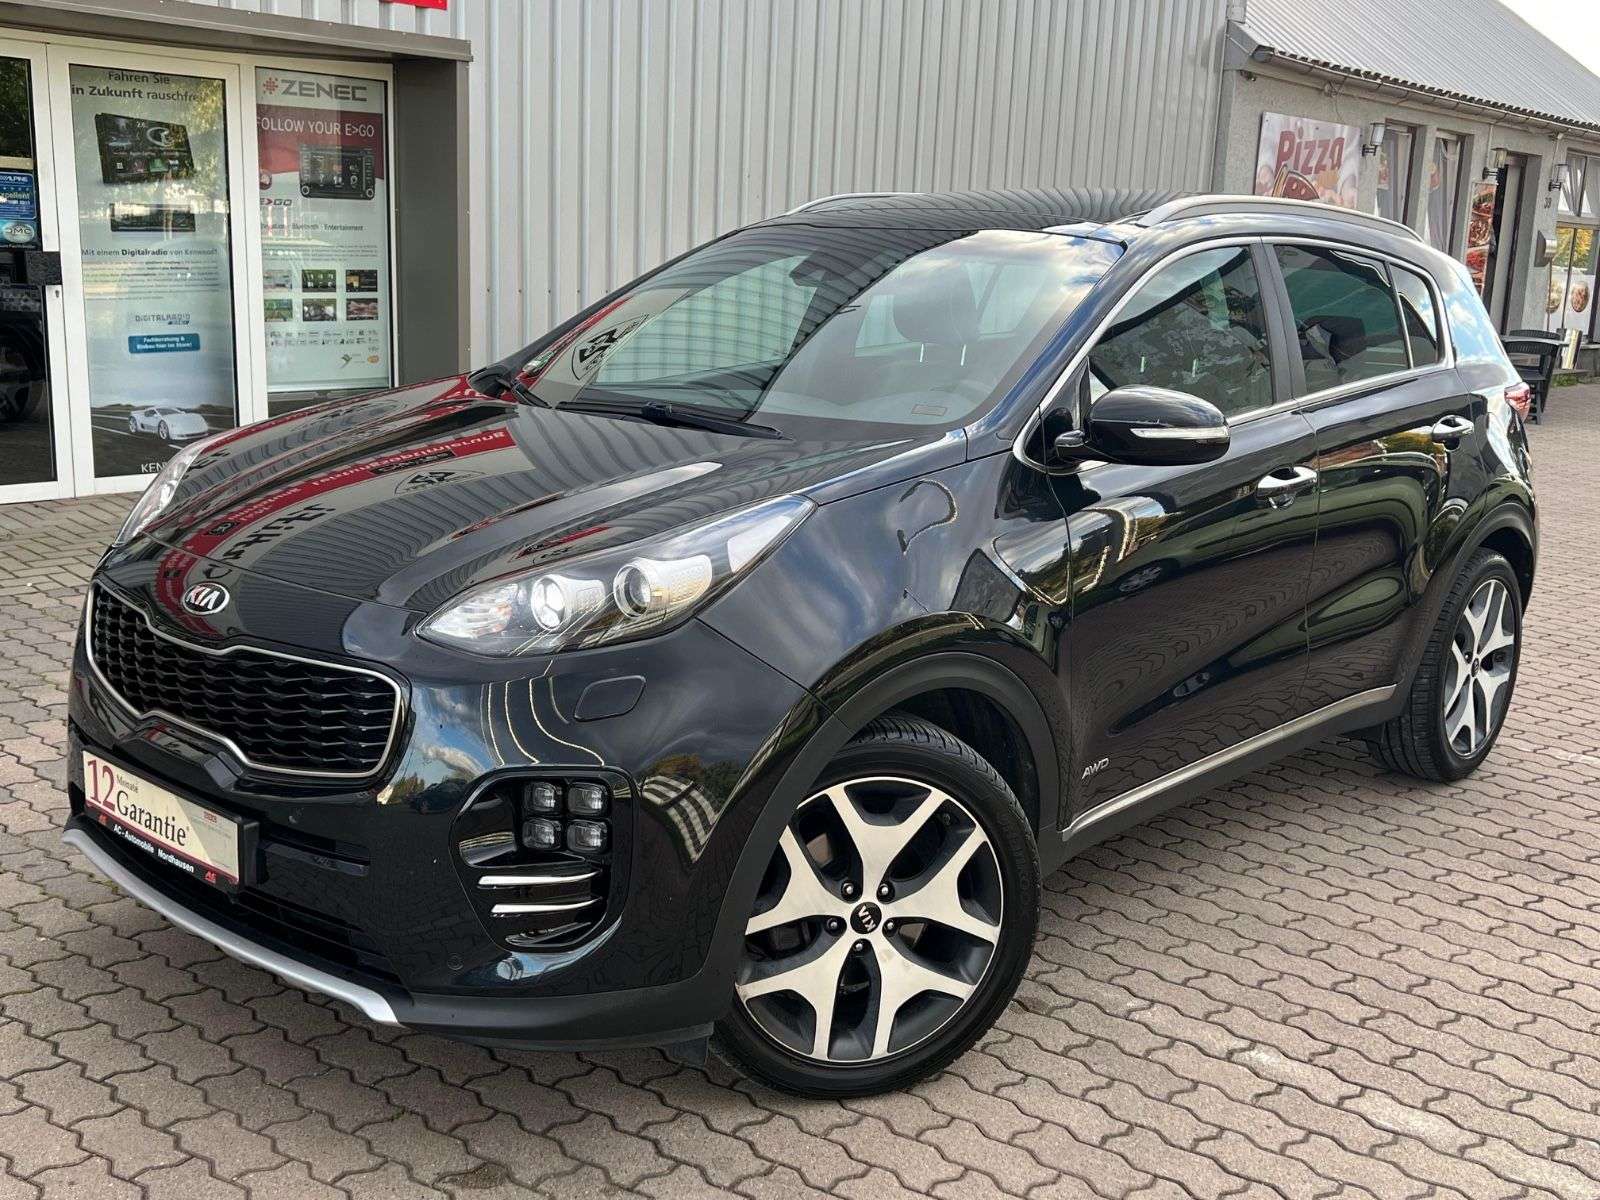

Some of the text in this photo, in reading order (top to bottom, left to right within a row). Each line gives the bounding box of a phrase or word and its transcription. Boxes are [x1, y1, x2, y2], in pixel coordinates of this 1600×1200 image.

[108, 72, 170, 84] Fahren Sie
[72, 85, 84, 95] in
[88, 85, 143, 99] Zukunft
[281, 79, 367, 102] ZENEC
[308, 120, 341, 135] YOUR
[1274, 126, 1345, 175] Pizza
[324, 223, 363, 231] Entertainment
[121, 249, 168, 257] Digitalradio
[186, 586, 220, 609] KIA
[1081, 757, 1109, 779] AWD
[87, 759, 115, 812] 12
[116, 790, 186, 847] Garantie
[157, 848, 195, 873] Nordhausen
[858, 905, 877, 932] KIA
